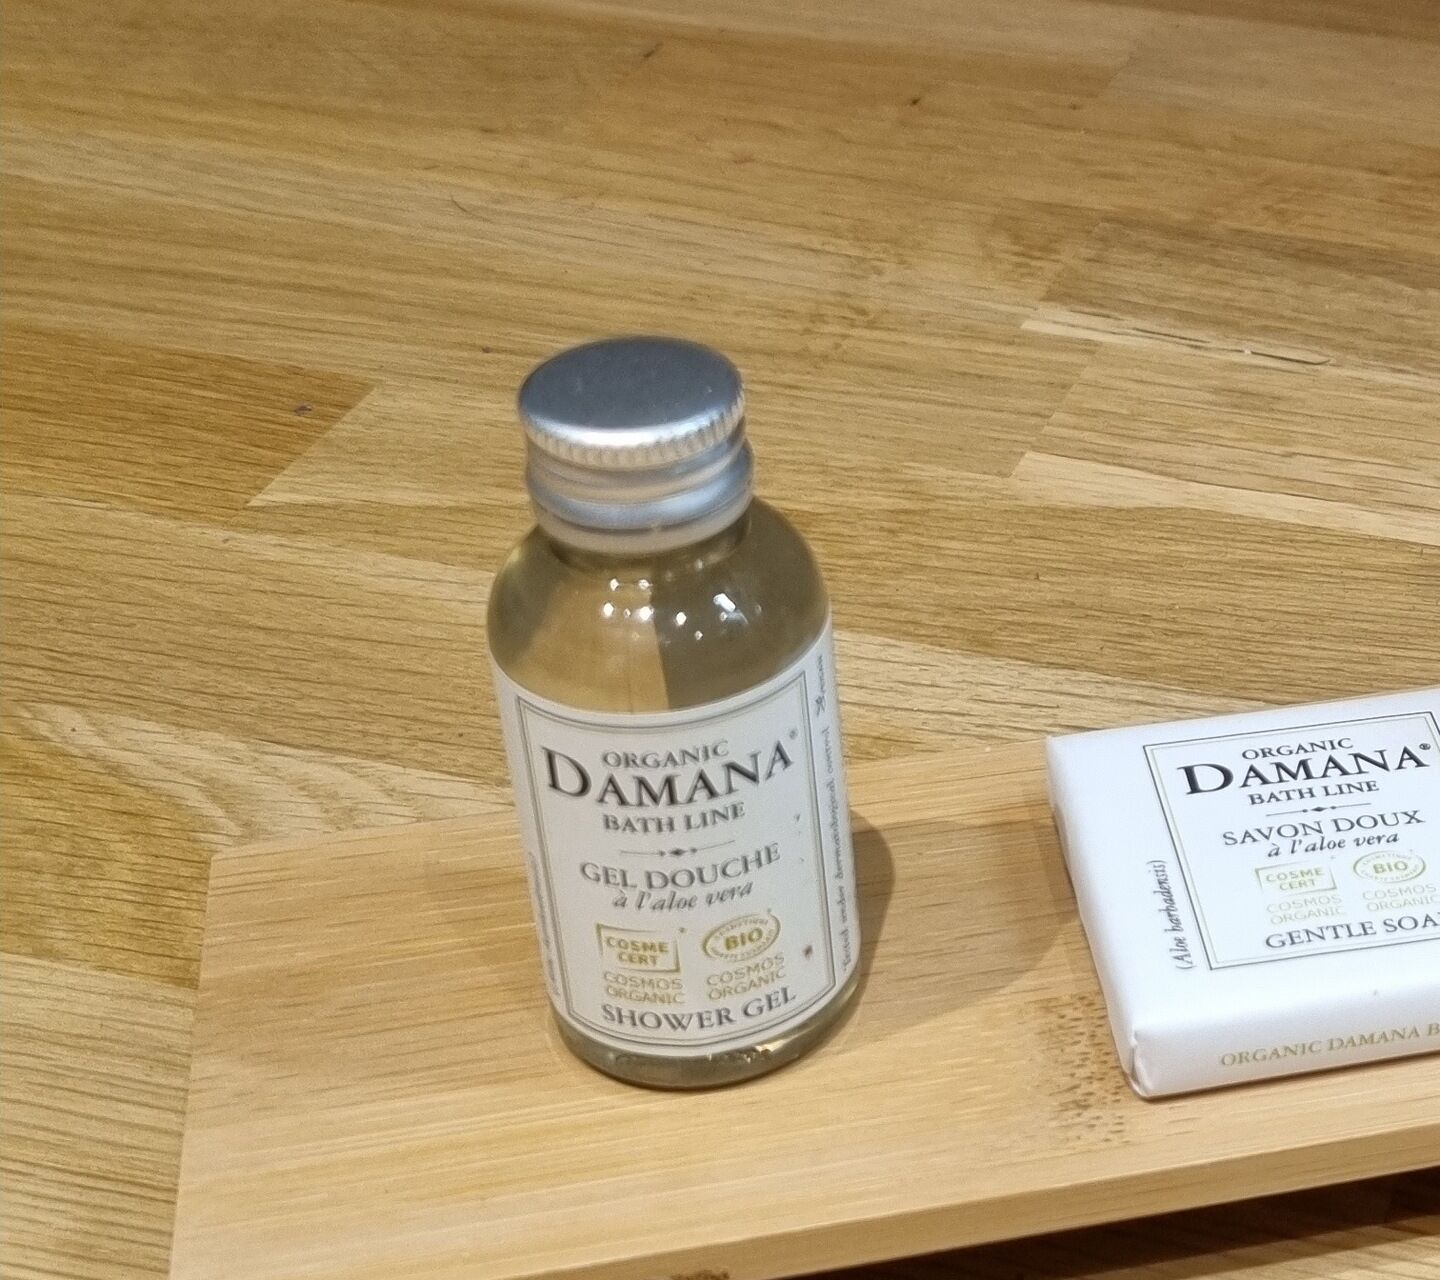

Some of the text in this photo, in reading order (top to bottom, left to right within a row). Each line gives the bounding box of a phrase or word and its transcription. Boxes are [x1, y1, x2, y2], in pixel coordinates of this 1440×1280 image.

[602, 739, 730, 769] ORGANIC
[1241, 737, 1354, 760] ORGANIC
[1248, 780, 1380, 806] BATH LINE
[603, 801, 745, 834] BATH LINE
[1222, 809, 1425, 846] SAVON DOUX
[1267, 832, 1400, 858] à l'aloe vera
[579, 842, 781, 889] GEL DOUCHE
[1265, 866, 1326, 883] COSME
[1372, 860, 1409, 875] BIO
[612, 880, 753, 912] à l'aloe vera
[1279, 879, 1317, 892] CERT
[1362, 883, 1438, 901] COSMOS
[1266, 894, 1343, 914] COSMOS
[1269, 905, 1348, 926] ORGANIC
[605, 935, 669, 954] COSME
[723, 927, 764, 951] BIO
[1265, 920, 1377, 949] GENTLE
[617, 952, 658, 967] CERT
[706, 952, 785, 986] COSMOS
[603, 970, 684, 991] COSMOS
[708, 966, 787, 1001] ORGANIC
[605, 984, 686, 1005] ORGANIC
[601, 986, 796, 1032] SHOWER GEL
[1219, 1040, 1322, 1067] ORGANIC
[1328, 1025, 1420, 1052] DAMANA
